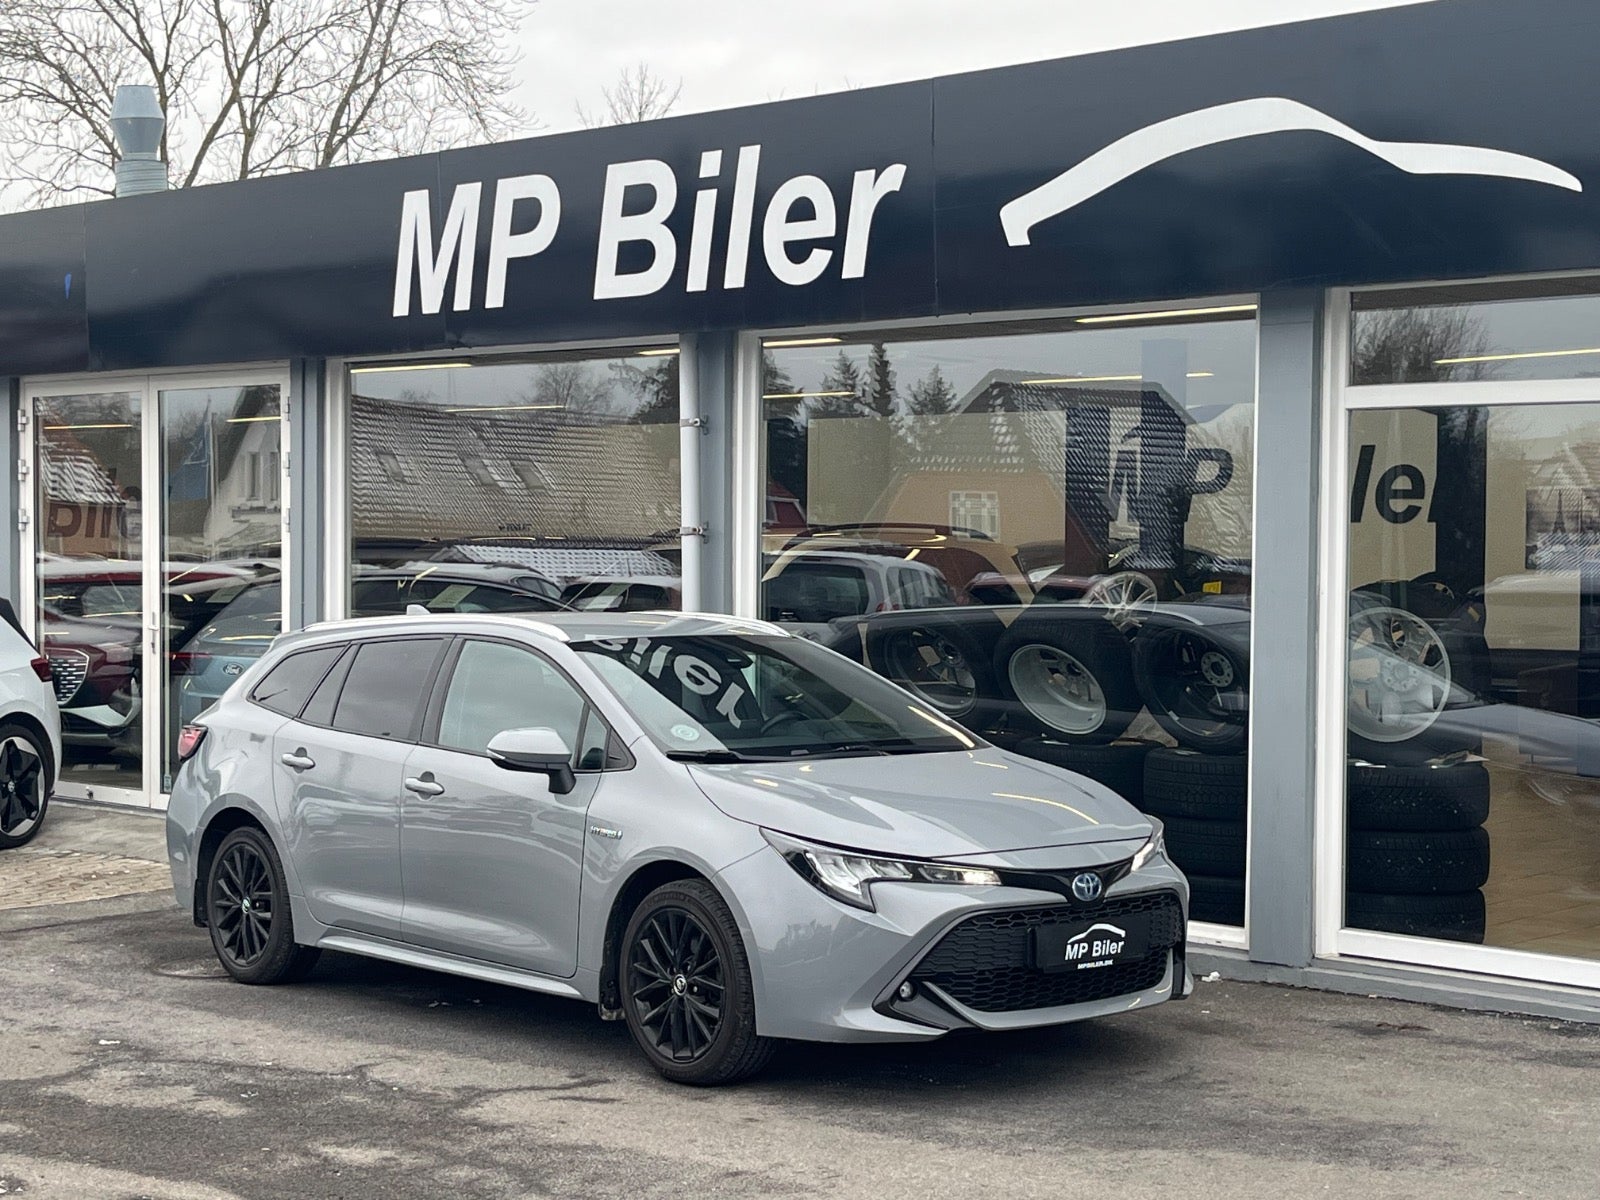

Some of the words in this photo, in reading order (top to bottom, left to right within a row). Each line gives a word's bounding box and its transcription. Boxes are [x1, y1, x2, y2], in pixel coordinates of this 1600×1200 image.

[393, 174, 561, 317] MP
[593, 144, 907, 301] Biler
[1065, 942, 1089, 960] MP
[1092, 939, 1125, 957] Biler
